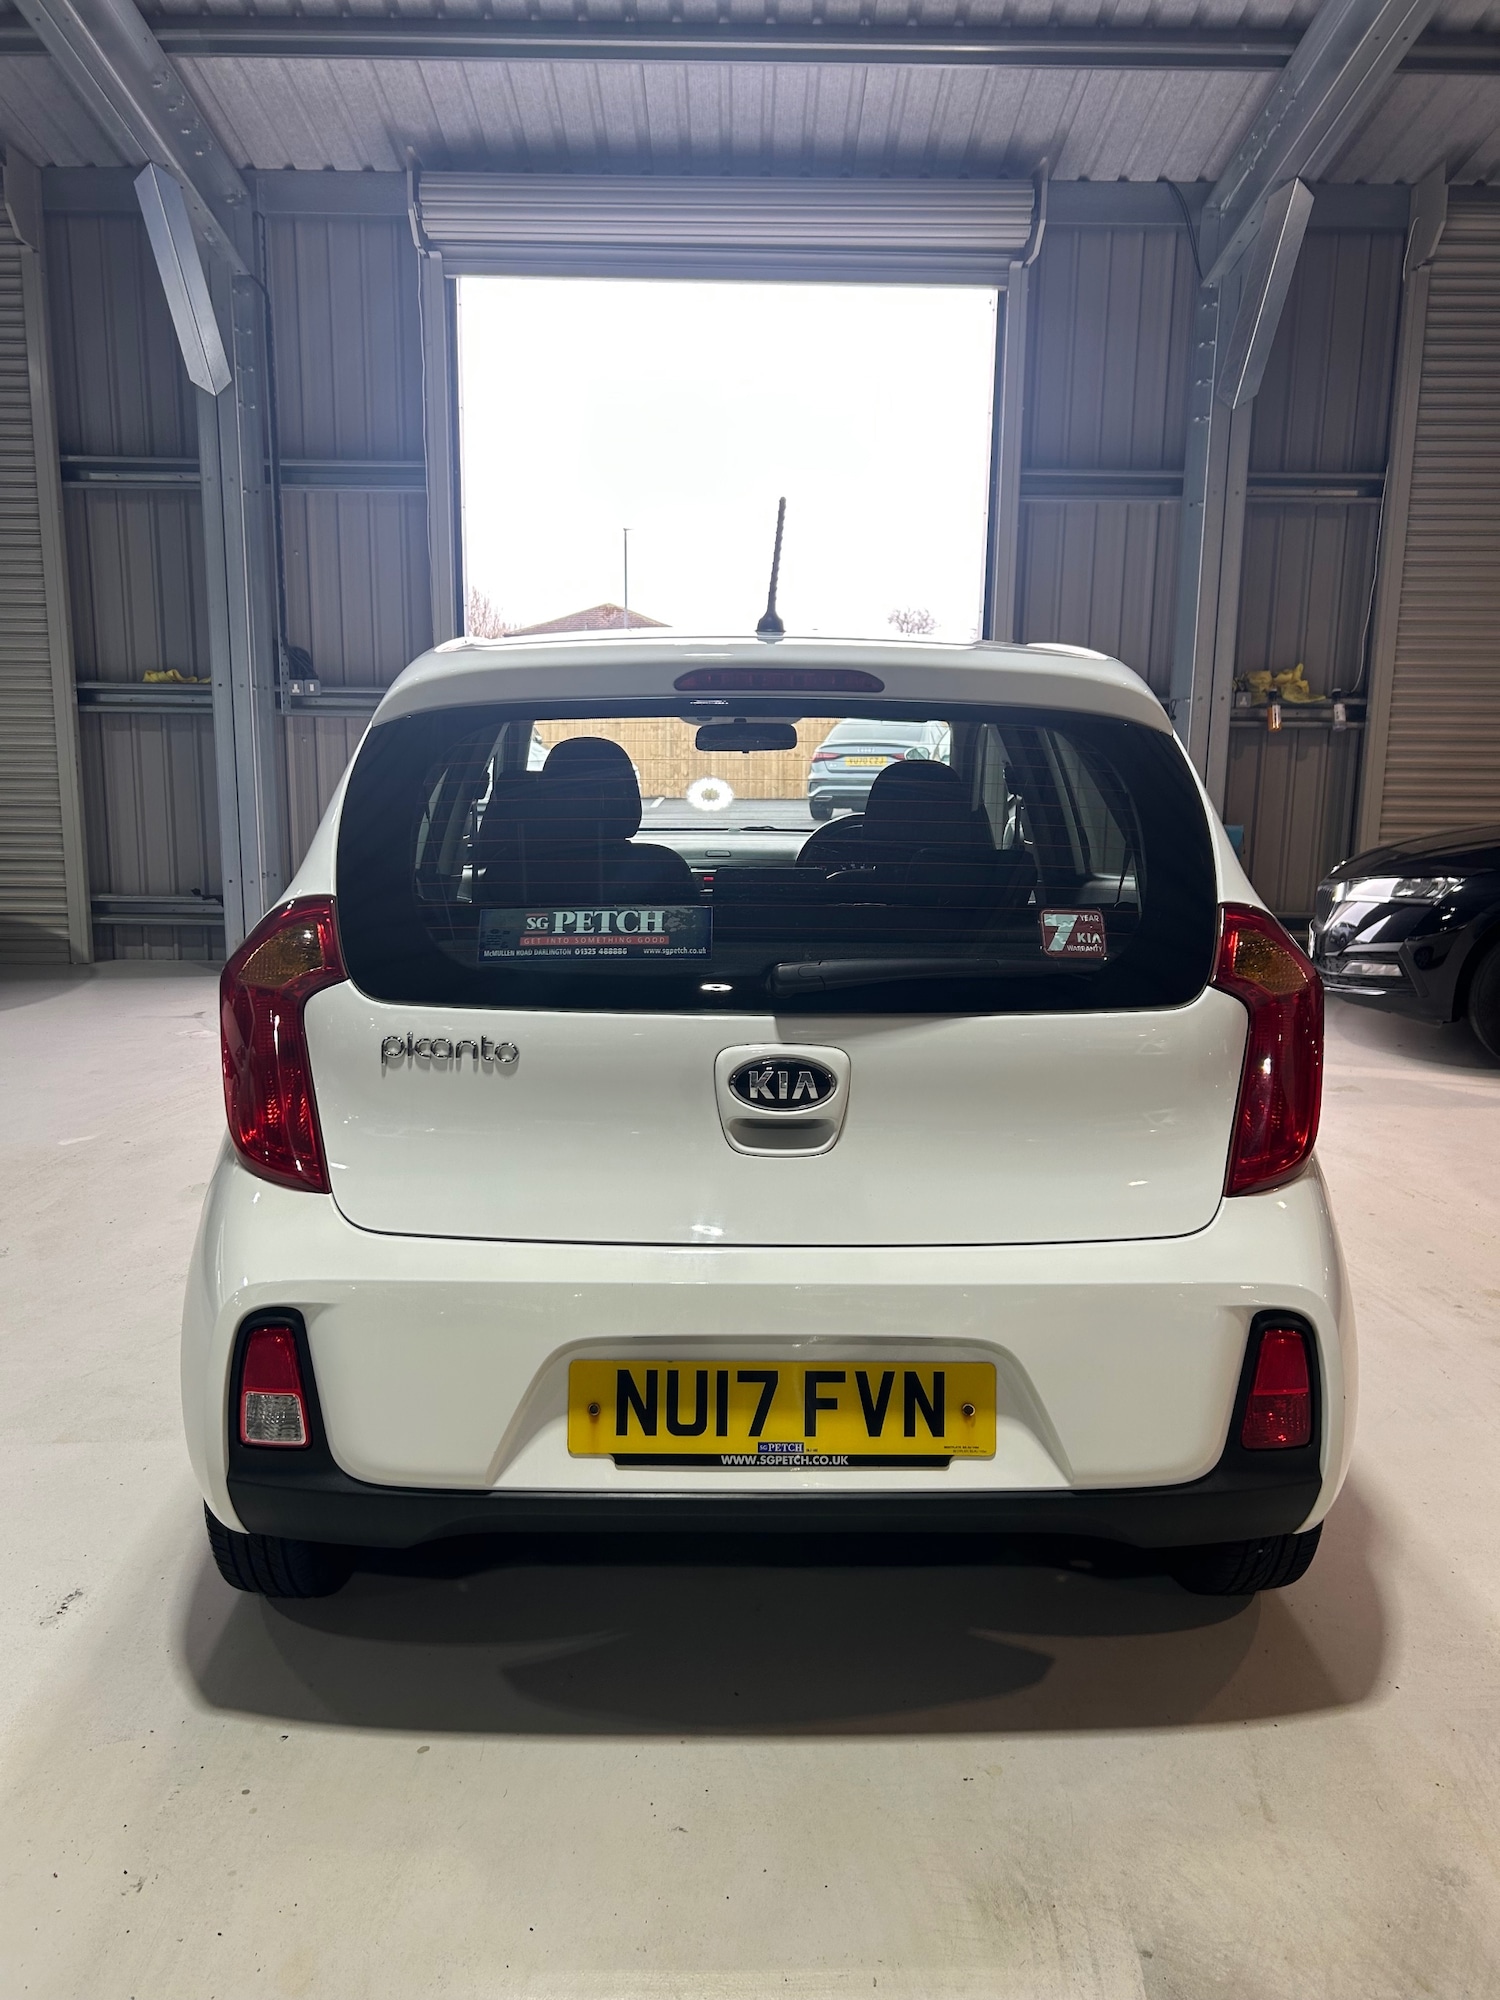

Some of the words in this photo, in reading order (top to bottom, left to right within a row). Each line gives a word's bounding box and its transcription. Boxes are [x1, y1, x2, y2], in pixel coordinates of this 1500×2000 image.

[526, 917, 549, 930] SG
[552, 910, 666, 934] PETCH
[1080, 914, 1099, 922] YEAR
[1043, 914, 1079, 951] 7
[1076, 932, 1102, 944] KIA
[546, 937, 569, 945] INTO
[575, 936, 632, 944] SOMETHING
[534, 948, 572, 956] DARLINGTON
[643, 946, 707, 955] www.sgpetch.co.uk
[381, 1031, 520, 1065] picanto
[748, 1070, 819, 1099] KIA
[615, 1369, 779, 1437] NU17
[804, 1370, 945, 1438] FVN
[768, 1442, 803, 1452] PETCH
[720, 1454, 849, 1466] WWW.SGPETCH.CO.UK
